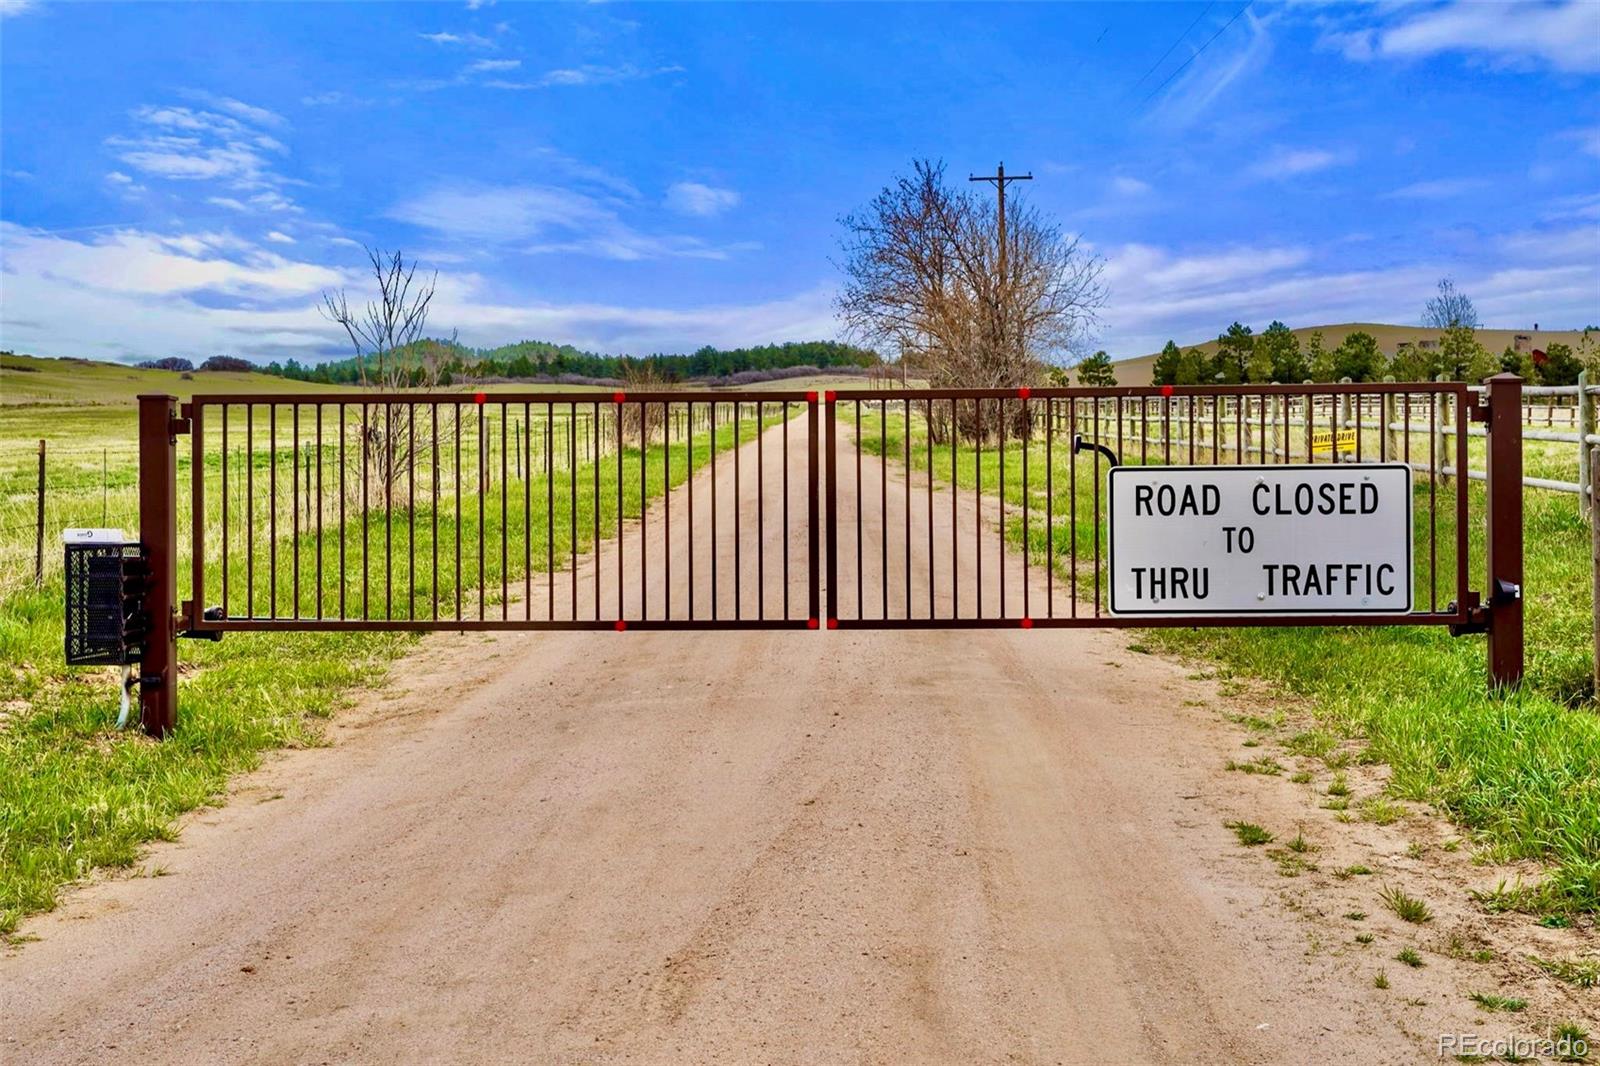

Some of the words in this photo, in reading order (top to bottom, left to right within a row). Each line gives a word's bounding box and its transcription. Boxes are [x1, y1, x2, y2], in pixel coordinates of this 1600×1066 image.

[1311, 433, 1334, 443] RIVATE
[1337, 432, 1355, 441] DRIVE
[1136, 485, 1220, 516] ROAD
[1253, 482, 1378, 515] CLOSED
[1223, 527, 1254, 553] TO
[1131, 568, 1208, 599] THRU
[1263, 564, 1394, 595] TRAFFIC
